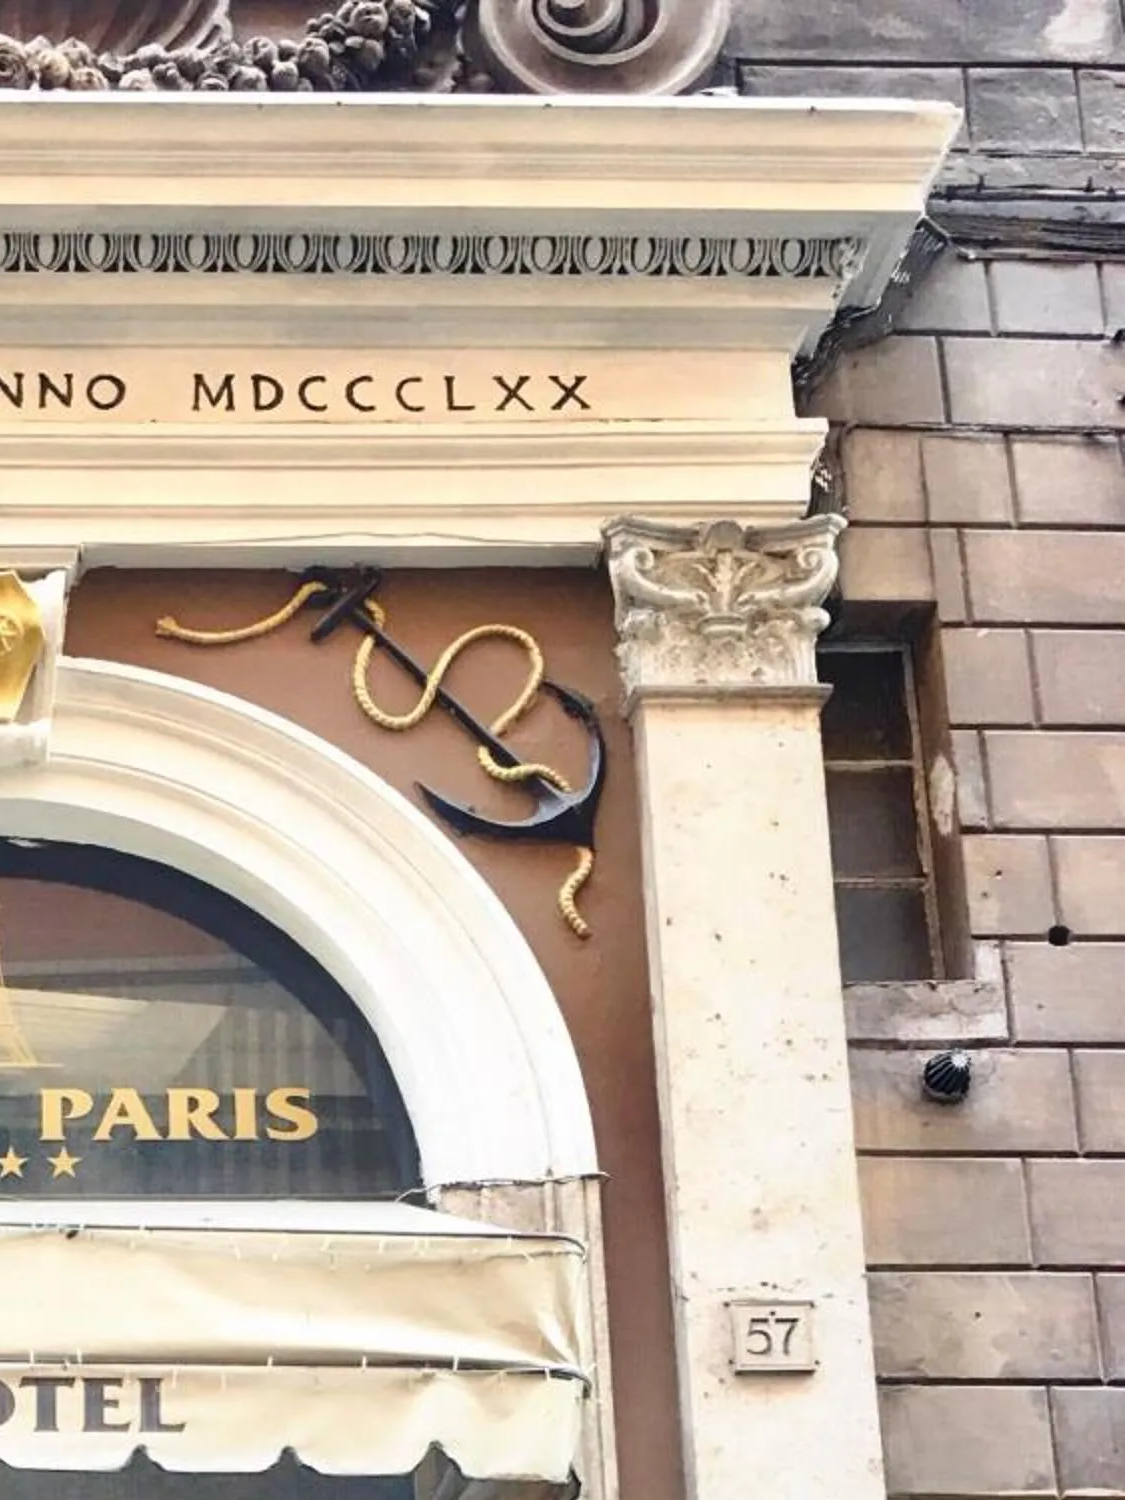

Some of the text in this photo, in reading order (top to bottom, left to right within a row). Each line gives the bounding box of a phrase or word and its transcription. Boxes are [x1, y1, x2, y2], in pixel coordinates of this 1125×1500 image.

[191, 372, 593, 412] MDCCCLXX
[39, 1086, 319, 1142] PARIS
[746, 1317, 800, 1356] 57
